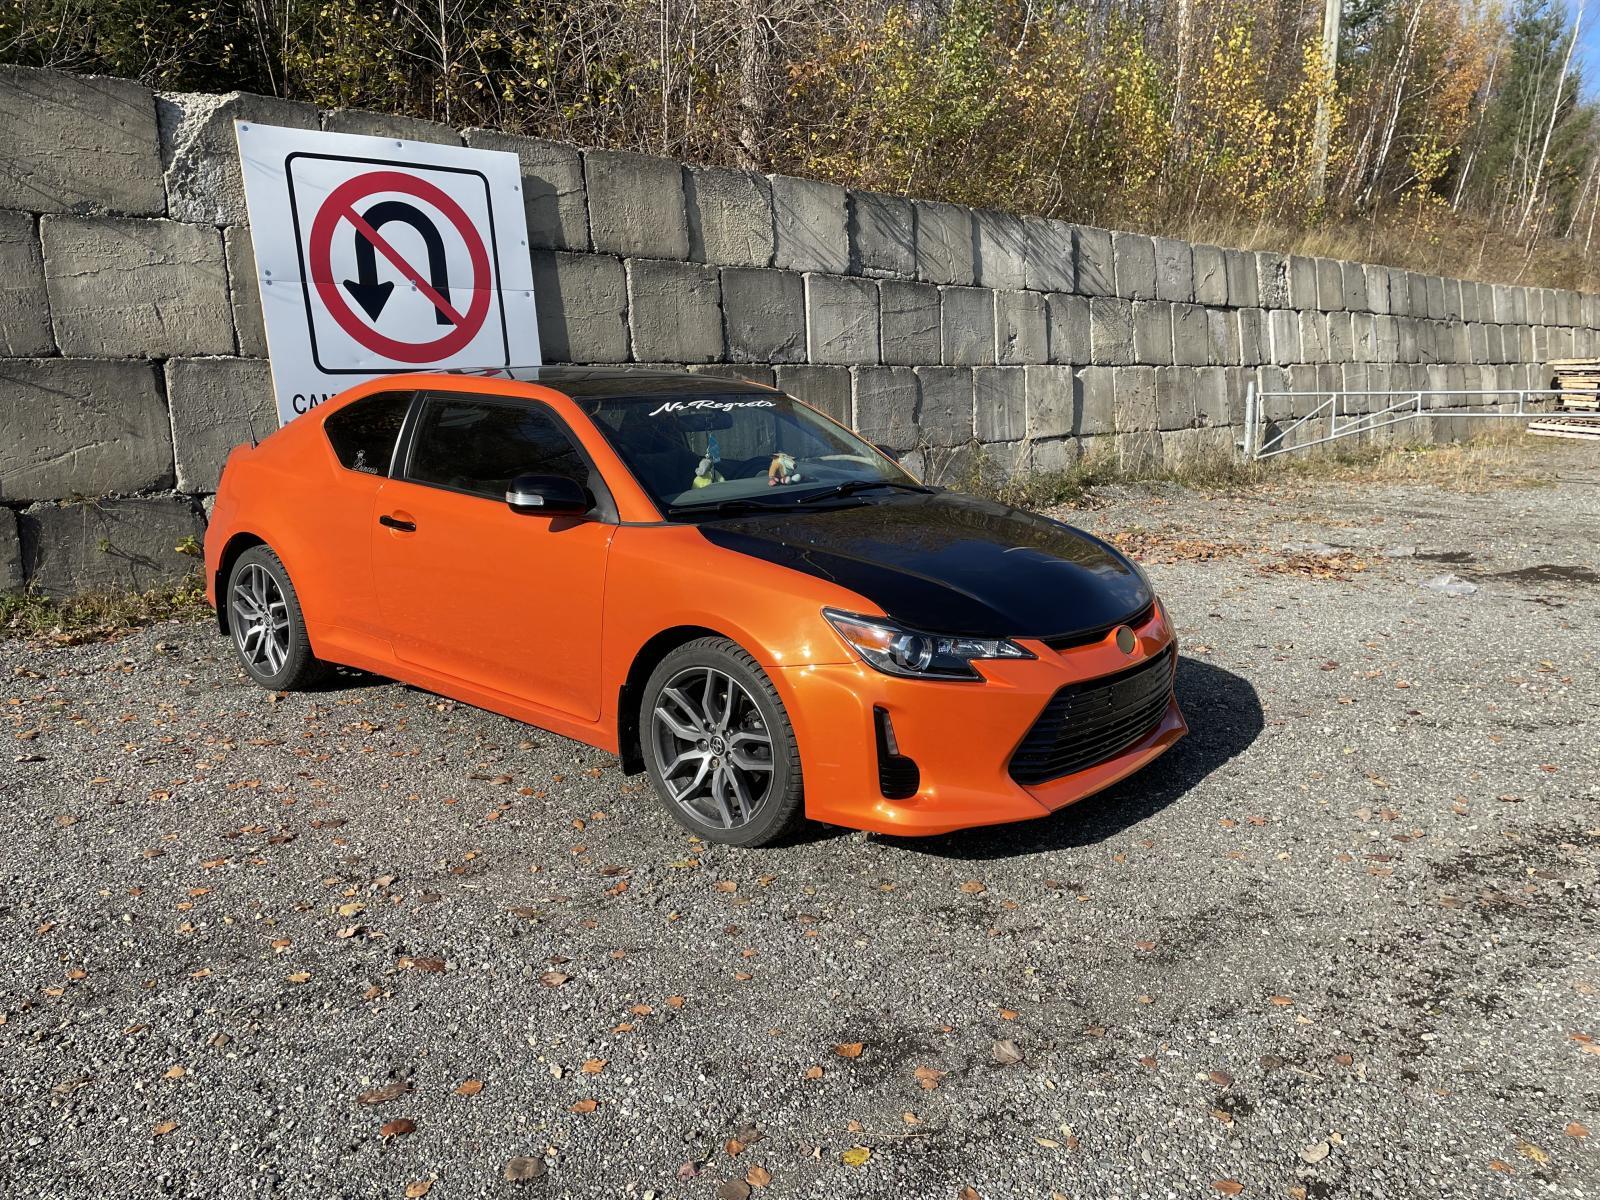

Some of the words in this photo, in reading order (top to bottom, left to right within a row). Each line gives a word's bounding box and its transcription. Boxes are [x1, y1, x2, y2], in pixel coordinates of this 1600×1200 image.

[649, 401, 688, 416] No
[687, 399, 777, 412] Regrets
[352, 457, 379, 475] Princess
